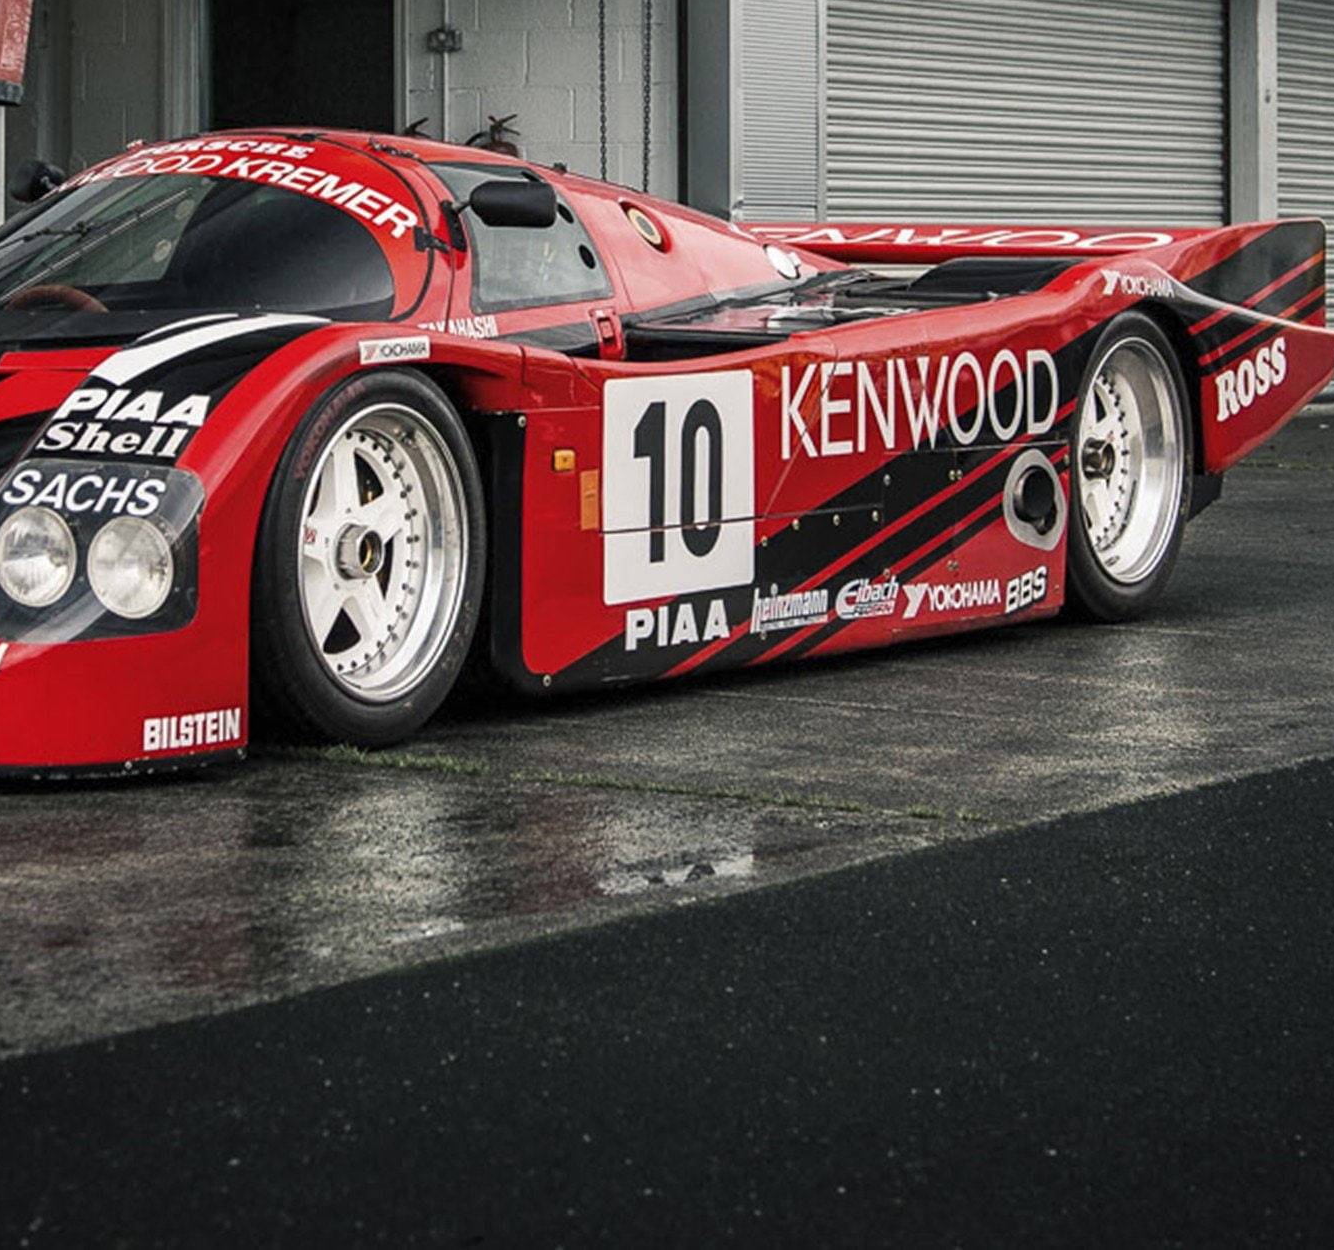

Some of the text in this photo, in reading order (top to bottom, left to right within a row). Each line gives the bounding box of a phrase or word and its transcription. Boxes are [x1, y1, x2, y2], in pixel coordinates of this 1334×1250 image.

[219, 156, 419, 240] KREMER
[729, 224, 1173, 248] ENWOO
[1119, 275, 1175, 297] YOKOHAMA
[1215, 337, 1287, 422] ROSS
[53, 388, 211, 426] PIAA
[781, 350, 1058, 460] KENWOOD
[35, 422, 189, 457] Shell
[2, 470, 166, 516] SACHS
[633, 398, 722, 564] 10
[835, 575, 900, 620] Eibach
[928, 579, 1001, 611] YOKOHAMA
[1005, 565, 1047, 613] BBS
[625, 599, 731, 650] PIAA
[143, 708, 241, 750] BILSTEIN
